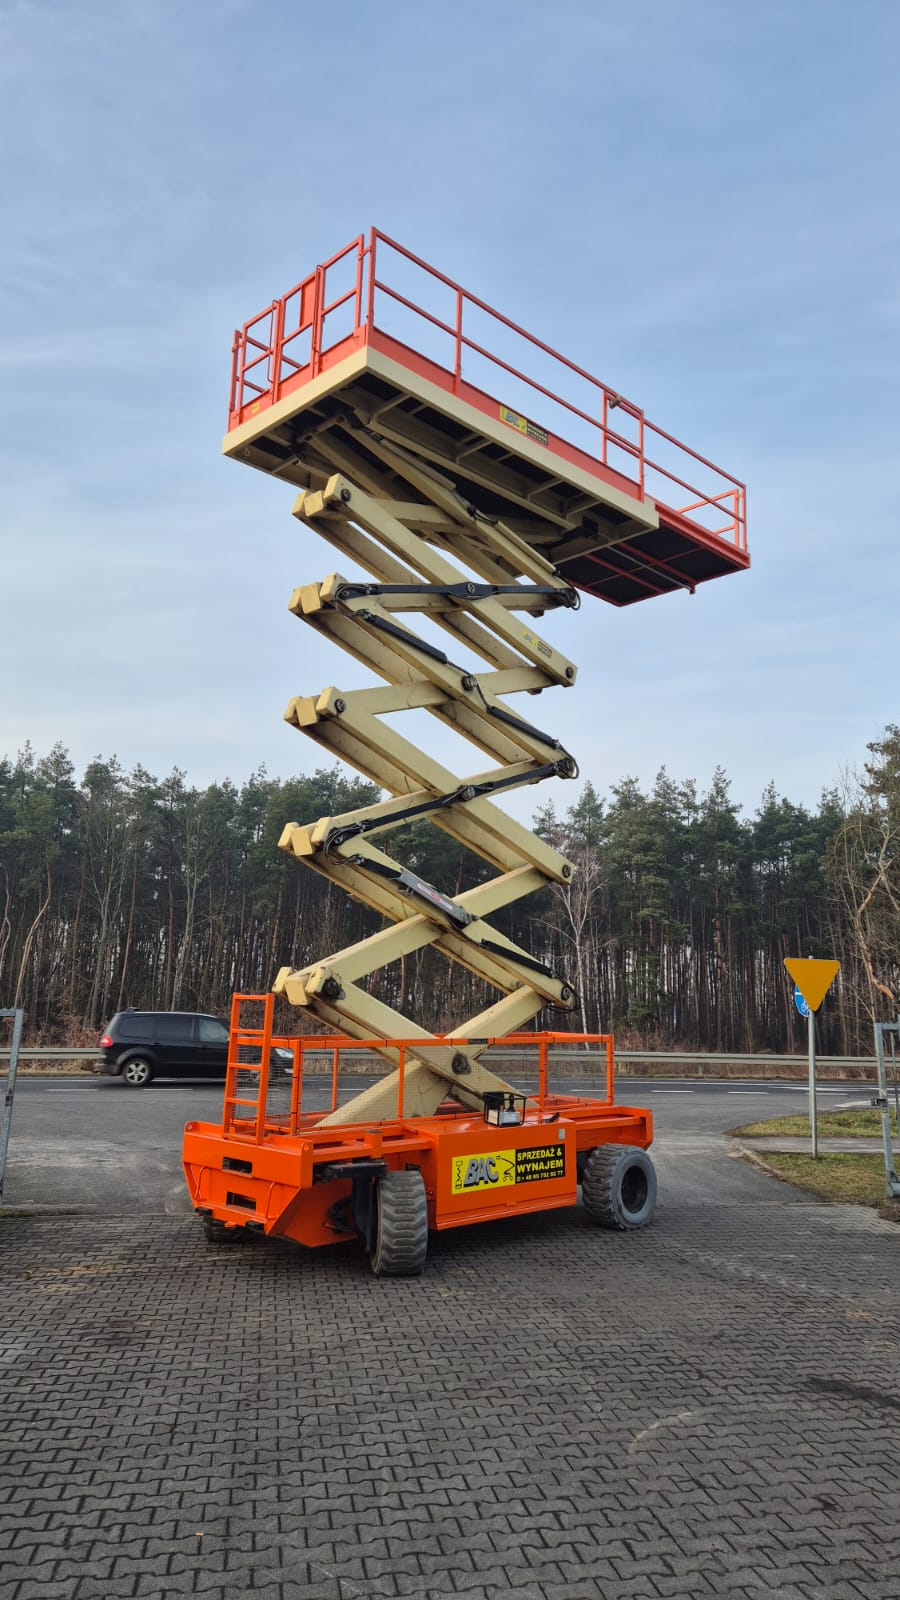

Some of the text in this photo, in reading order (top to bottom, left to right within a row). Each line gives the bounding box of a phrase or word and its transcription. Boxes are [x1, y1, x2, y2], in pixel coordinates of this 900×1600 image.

[517, 1147, 555, 1161] SPRZEDAŻ
[464, 1157, 499, 1188] BAC
[517, 1159, 563, 1173] WYNAJEM
